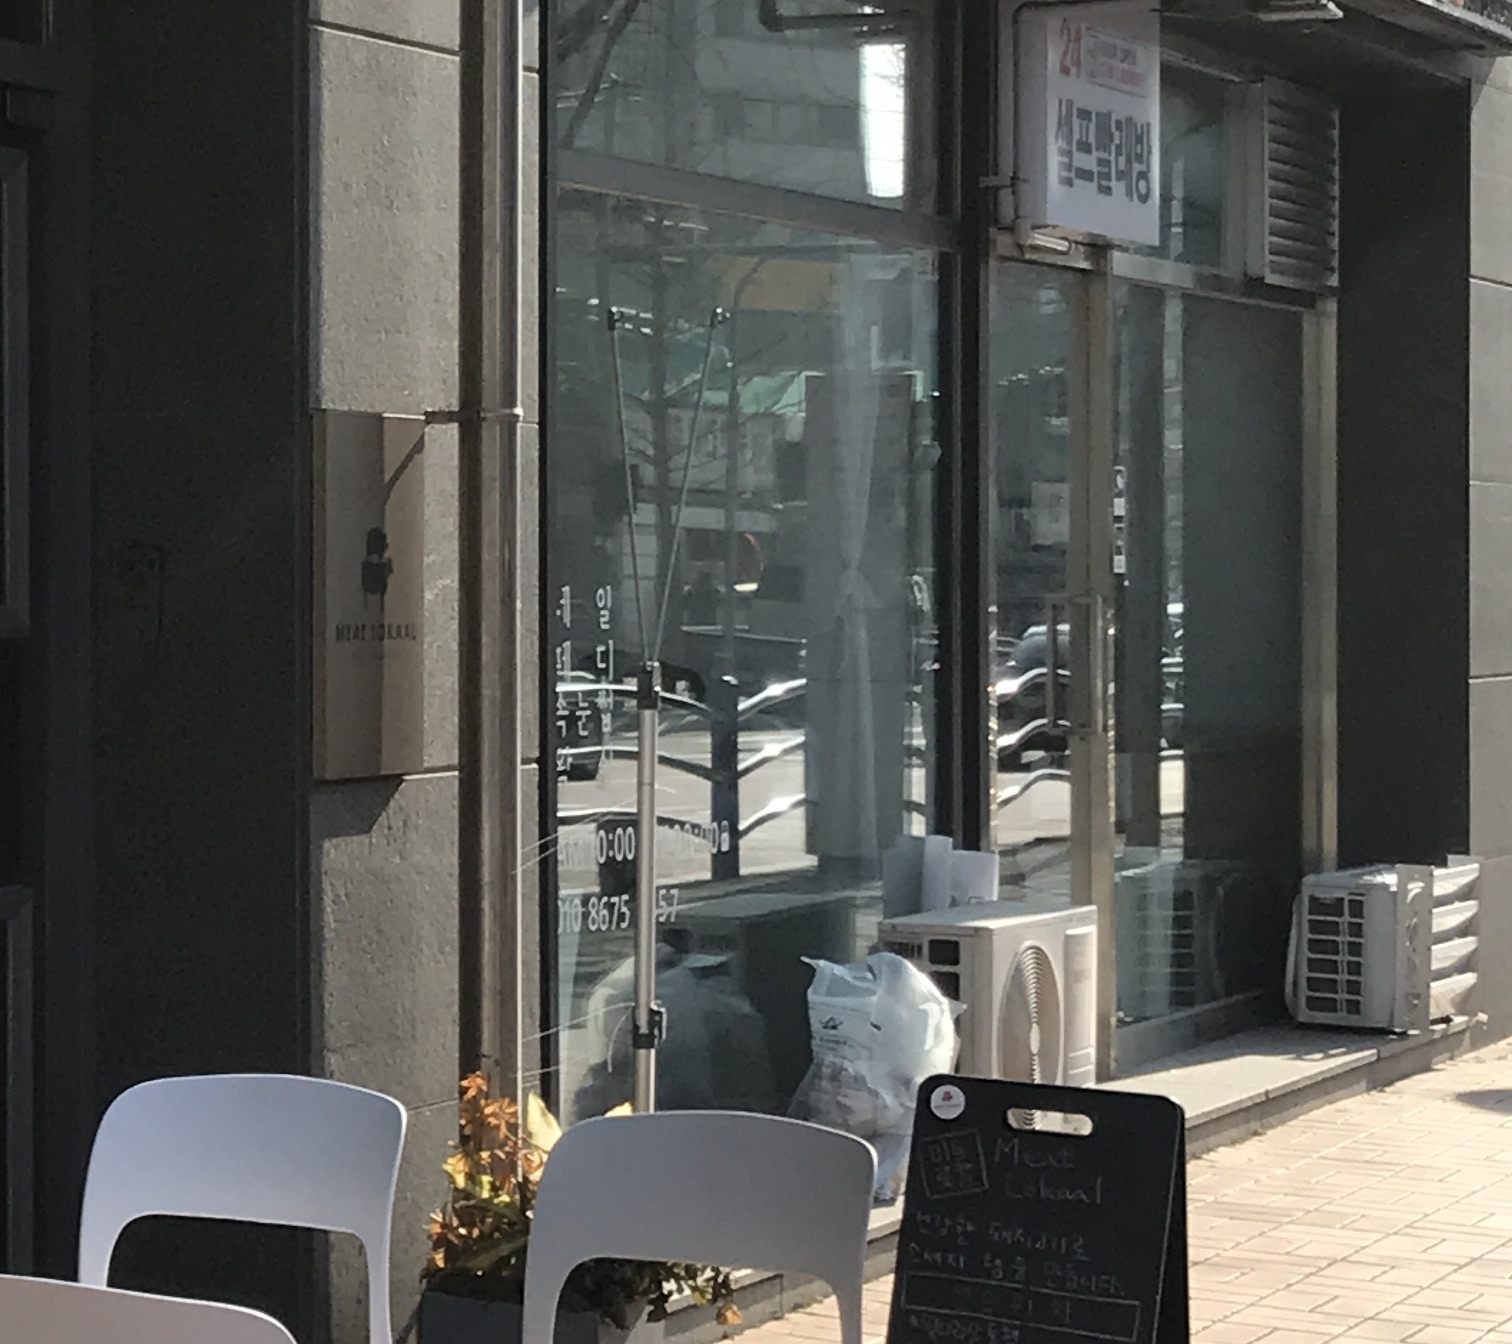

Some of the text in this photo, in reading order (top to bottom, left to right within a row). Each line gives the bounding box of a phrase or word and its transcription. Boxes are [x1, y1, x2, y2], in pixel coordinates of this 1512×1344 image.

[1058, 18, 1082, 79] 24
[1054, 97, 1153, 205] 셀프빨래방
[587, 894, 631, 933] 8675
[993, 1136, 1076, 1169] Meat
